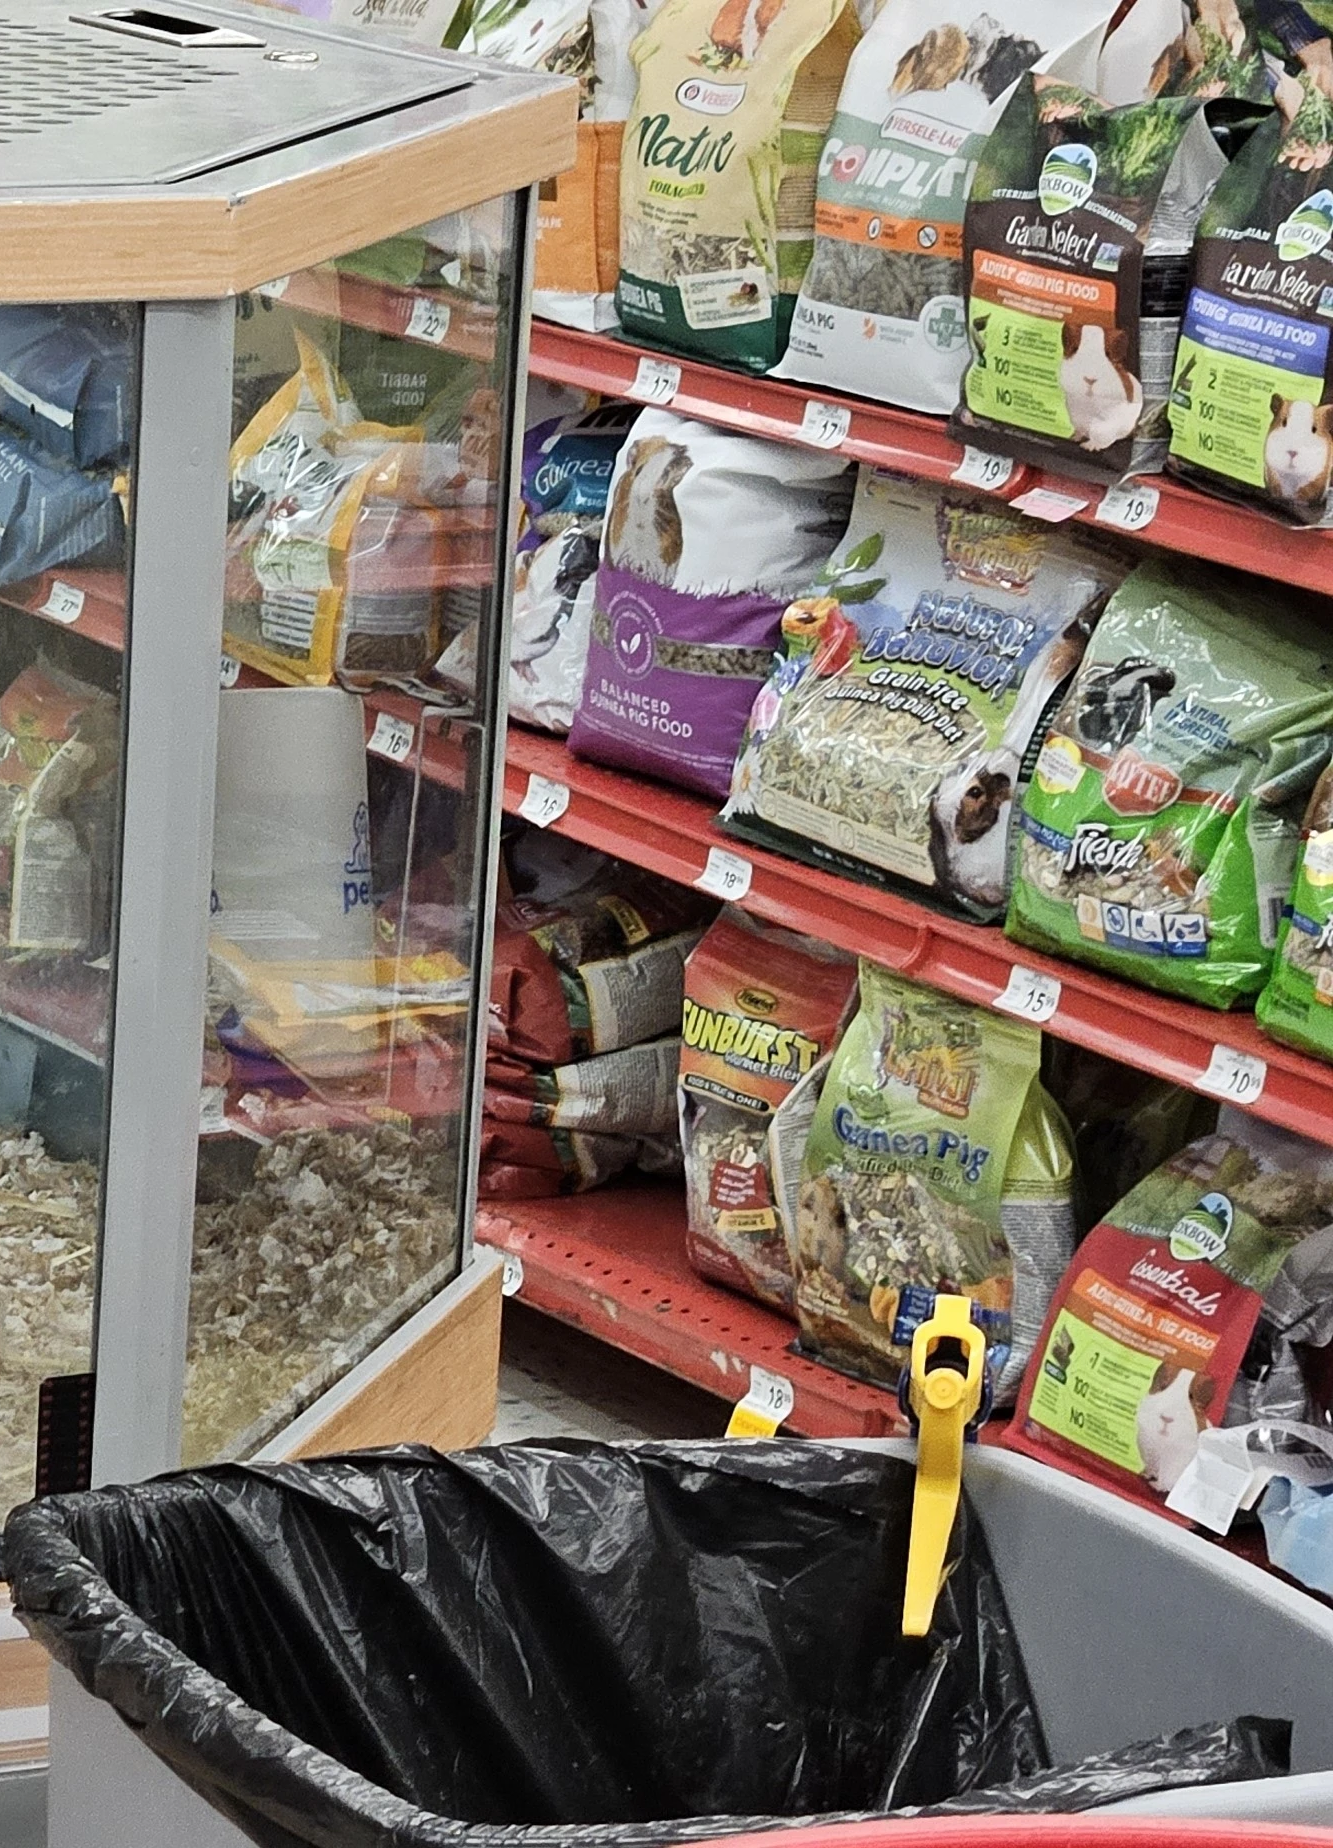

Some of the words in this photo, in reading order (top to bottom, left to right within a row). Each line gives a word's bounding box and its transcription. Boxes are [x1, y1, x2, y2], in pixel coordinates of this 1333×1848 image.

[1049, 219, 1098, 262] Select
[979, 258, 1017, 280] ADULT
[1046, 276, 1065, 294] PIG
[1066, 280, 1100, 302] FOOD
[1262, 318, 1284, 338] PIG
[1283, 324, 1318, 347] FOOD
[996, 386, 1013, 406] NO
[1207, 372, 1218, 391] 2
[535, 456, 613, 495] Guinea
[600, 678, 671, 716] BALANCED
[868, 667, 970, 711] Grain-Free
[589, 688, 627, 720] GUINEA
[628, 708, 650, 728] PIG
[651, 715, 693, 738] FOOD
[882, 691, 906, 711] Pig
[904, 699, 939, 725] Daily
[934, 713, 964, 743] Diet
[1163, 708, 1237, 752] INGREDIEN
[1175, 697, 1233, 734] NATURAL
[769, 1063, 803, 1084] Blen
[735, 1094, 764, 1109] ONE!
[936, 1130, 991, 1184] Pig
[1069, 1406, 1085, 1429] NO
